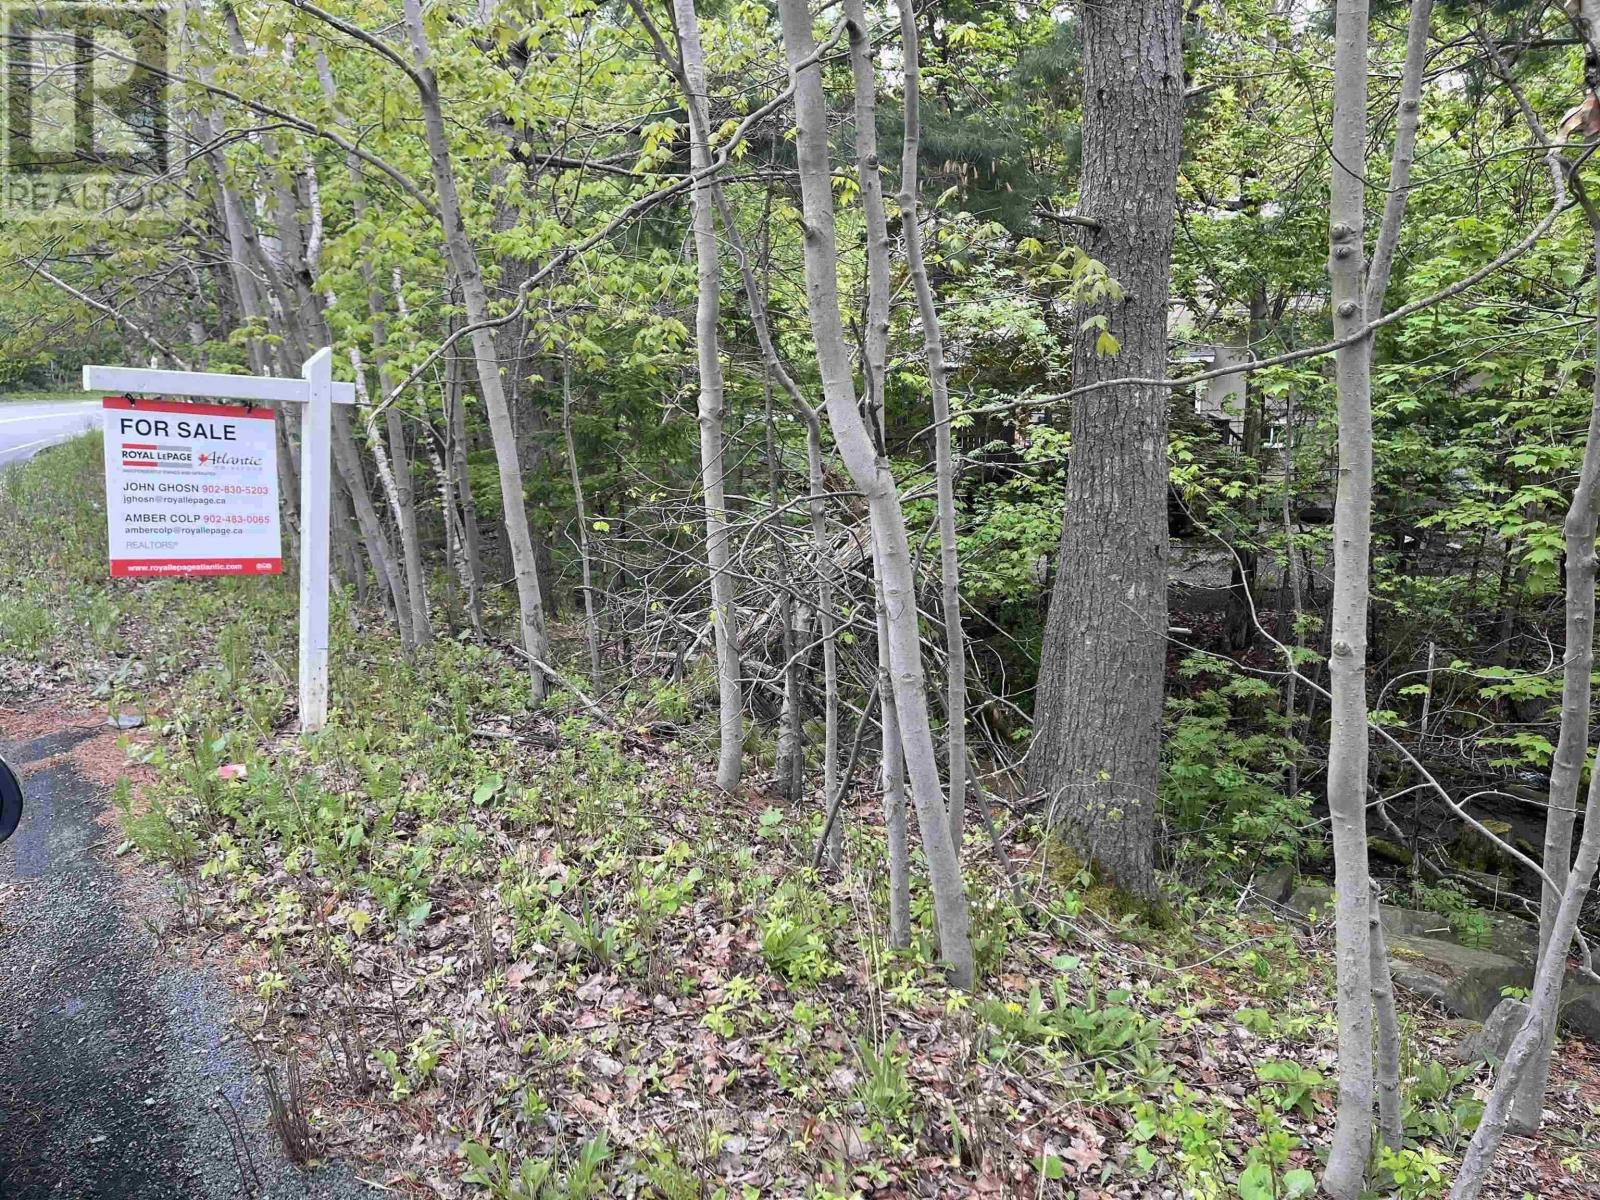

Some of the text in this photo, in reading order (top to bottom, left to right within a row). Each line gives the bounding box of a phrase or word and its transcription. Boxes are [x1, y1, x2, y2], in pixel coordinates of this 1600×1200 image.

[120, 417, 237, 441] FOR SALE
[122, 450, 155, 460] ROYAL
[204, 450, 264, 466] Atlantic
[123, 482, 155, 492] JOHN
[158, 483, 199, 493] GHOSN
[123, 495, 226, 505] jghosn@royallepage.ca
[125, 514, 167, 523] AMBER
[170, 514, 201, 523] COLP
[125, 525, 243, 536] ambercolp@royallepage.ca
